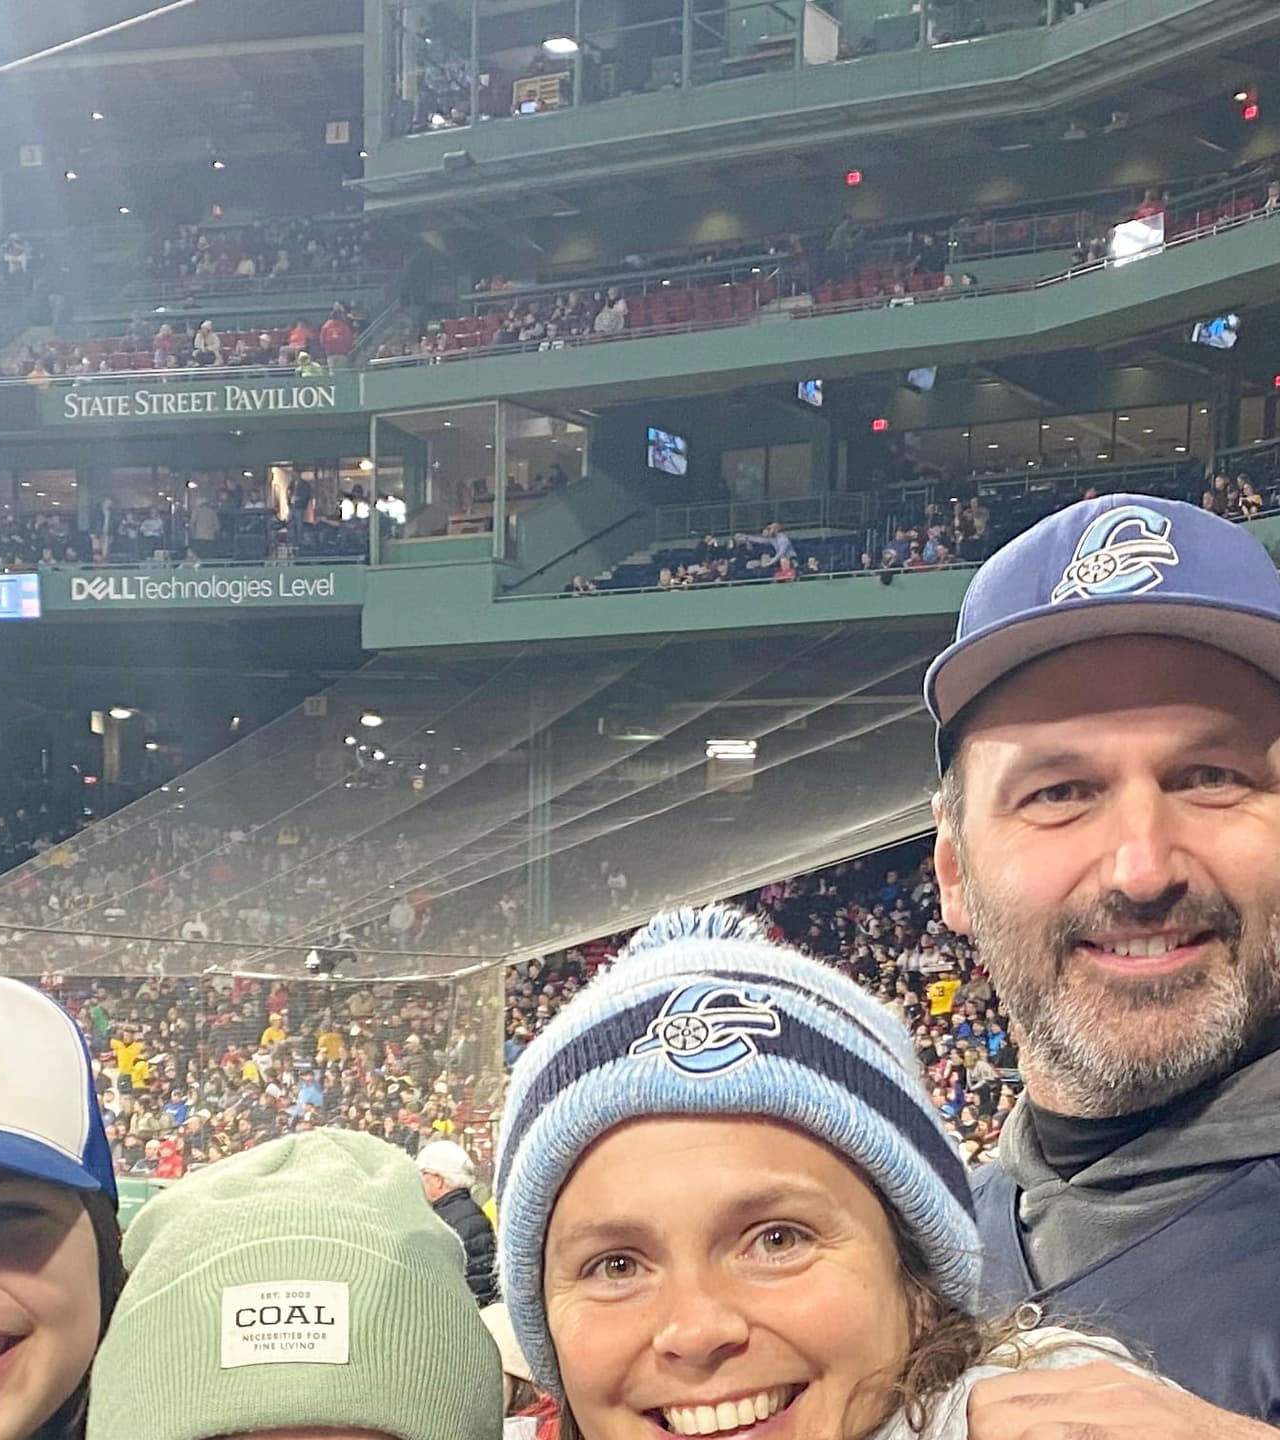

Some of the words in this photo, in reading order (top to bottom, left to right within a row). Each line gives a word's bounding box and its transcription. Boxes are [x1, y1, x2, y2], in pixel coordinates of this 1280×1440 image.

[63, 393, 130, 418] STATE
[134, 390, 216, 415] STREET
[224, 385, 336, 412] PAVILION
[279, 572, 335, 597] Level
[235, 1305, 335, 1328] COAL
[242, 1331, 302, 1342] NECESSITIES
[306, 1331, 327, 1340] FOR
[253, 1343, 276, 1351] FINE
[280, 1341, 316, 1351] LIVING
